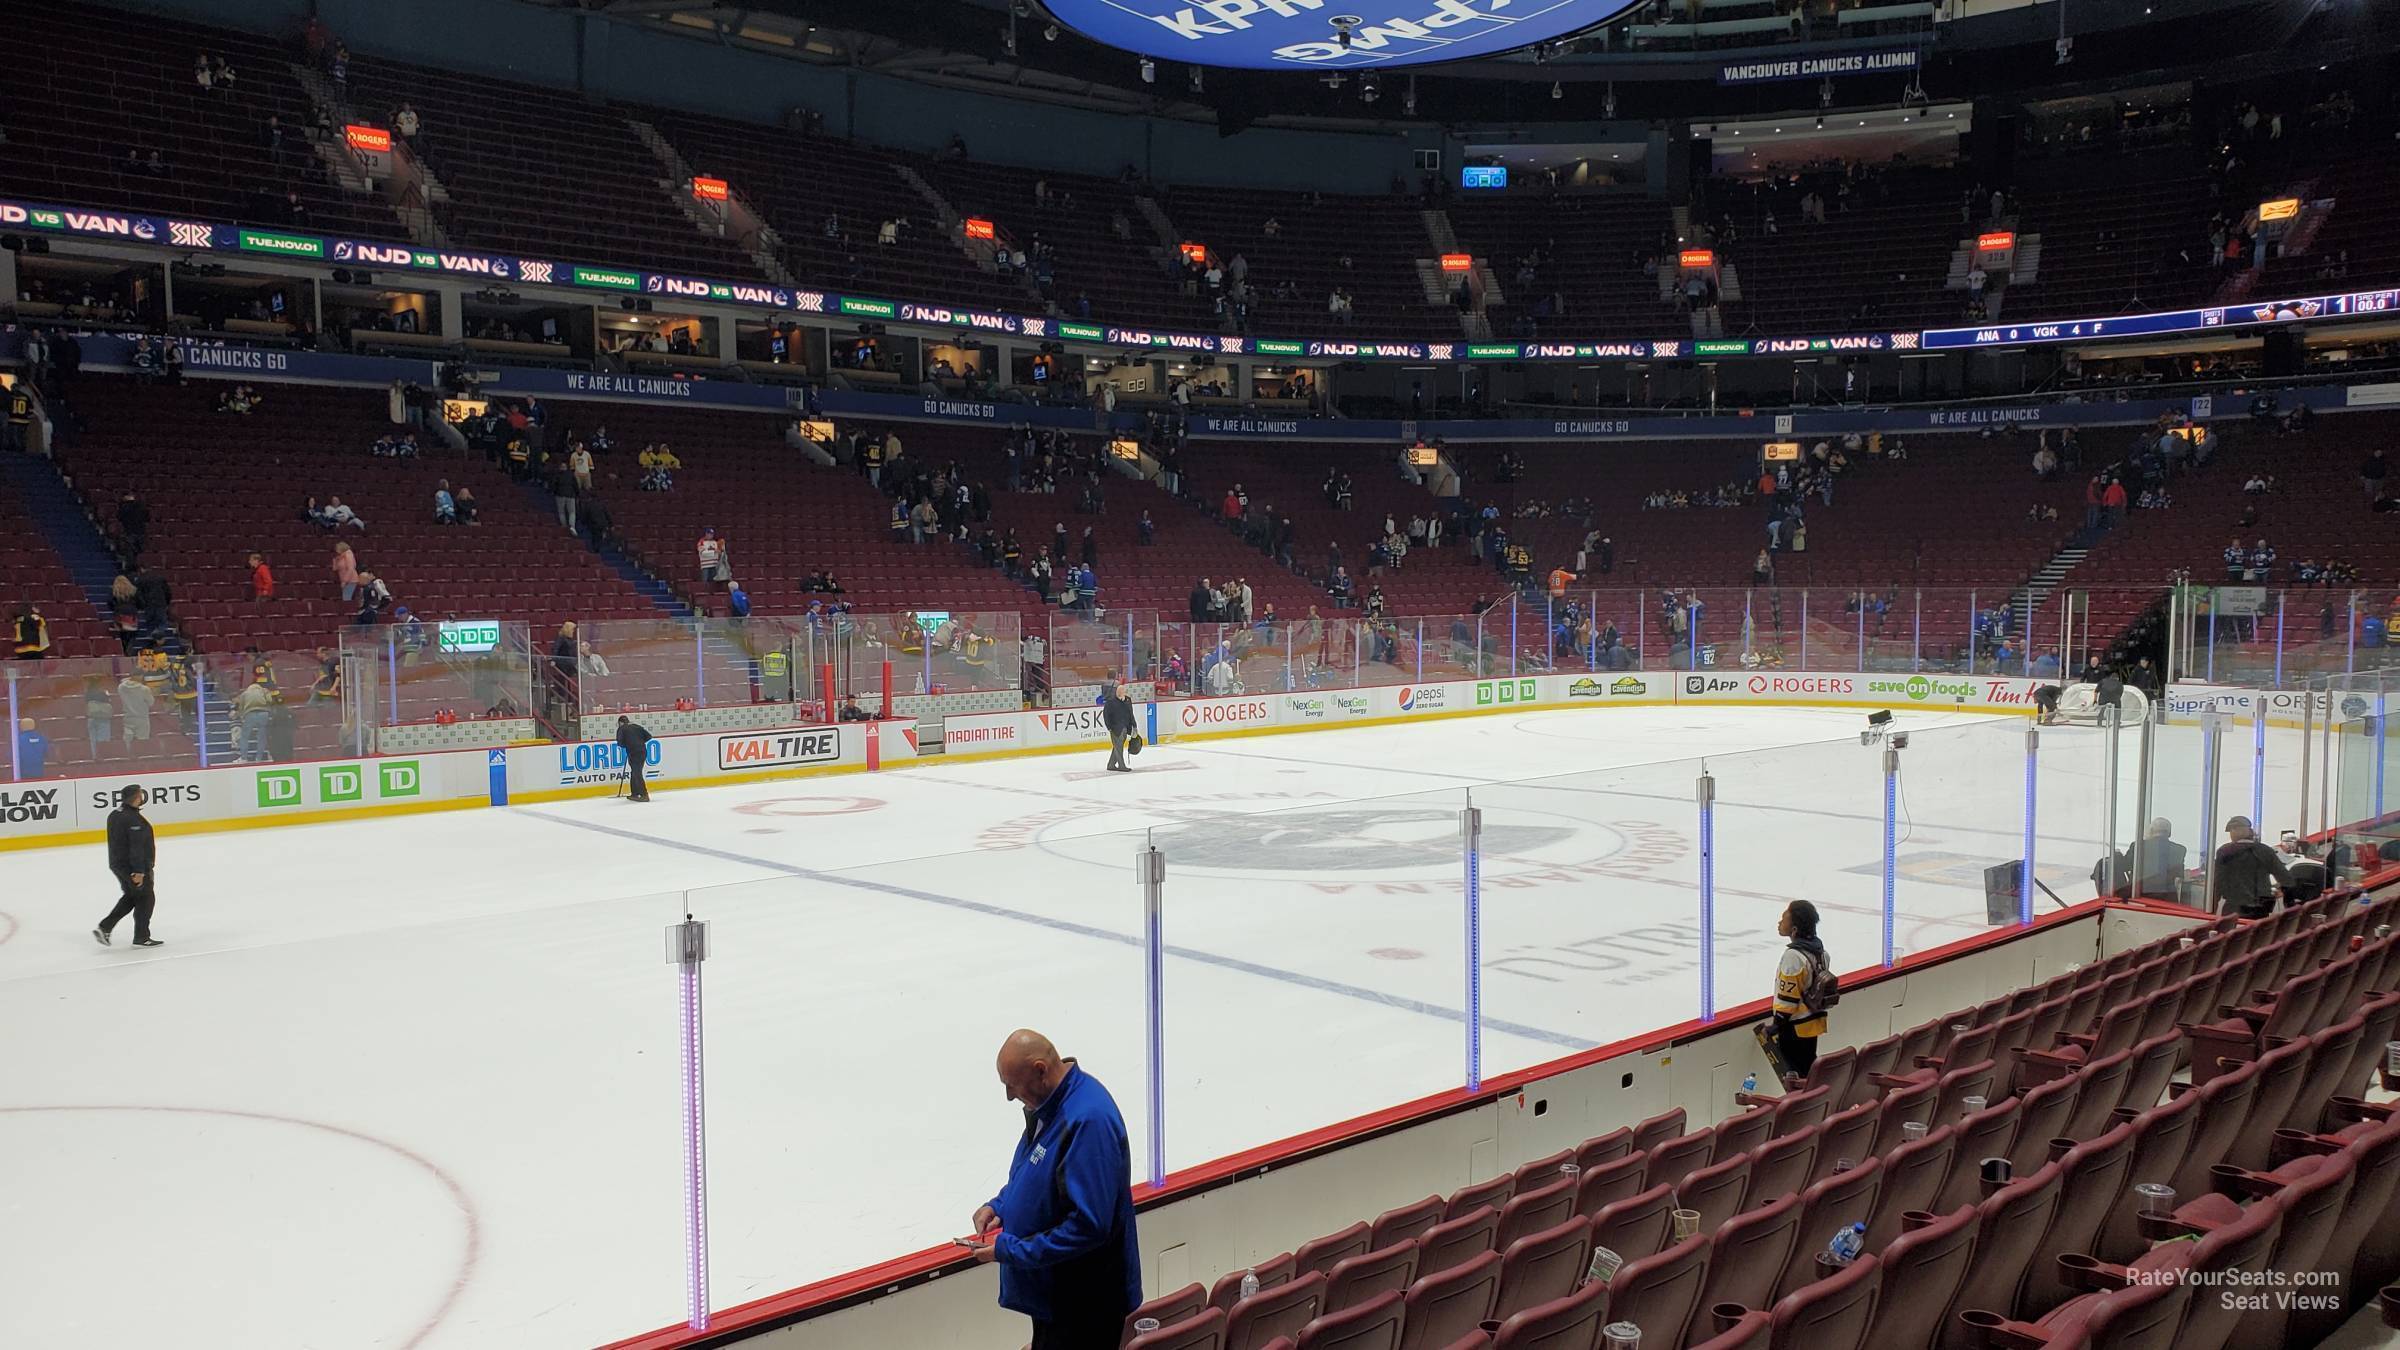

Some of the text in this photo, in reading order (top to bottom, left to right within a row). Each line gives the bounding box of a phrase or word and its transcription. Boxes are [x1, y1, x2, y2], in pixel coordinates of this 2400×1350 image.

[1724, 52, 1916, 81] VANCOUVER CANUCKS ALUMNI
[357, 134, 388, 145] ROGERS
[65, 213, 129, 235] VAN
[246, 237, 318, 252] TUE.NOV.01
[358, 246, 412, 264] NJD
[440, 255, 489, 273] VAN
[666, 279, 710, 296] NJD
[732, 287, 772, 303] VAN
[2335, 297, 2346, 313] 1
[2358, 299, 2385, 311] 00.0
[917, 308, 952, 323] NJD
[970, 314, 1003, 329] VAN
[1121, 331, 1152, 345] NJD
[1169, 335, 1201, 348] VAN
[1976, 331, 2000, 342] ANA
[2033, 326, 2058, 337] VGK
[2072, 325, 2080, 334] 4
[2094, 323, 2102, 333] F
[1324, 344, 1358, 356] NJD
[1376, 345, 1408, 357] VAN
[1540, 346, 1576, 357] NJD
[1595, 345, 1630, 356] VAN
[1771, 340, 1809, 351] NJD
[1830, 337, 1868, 349] VAN
[191, 348, 262, 368] CANUCKS
[267, 354, 287, 370] GO
[567, 374, 690, 396] WE ARE ALL CANUCKS
[924, 400, 995, 418] GO CANUCKS GO
[2193, 398, 2210, 410] 122
[1777, 418, 1790, 427] 121
[1930, 408, 2040, 424] WE ARE ALL CANUCKS
[1208, 419, 1297, 433] WE ARE ALL CANUCKS
[1555, 421, 1629, 433] GO CANUCKS GO
[1703, 653, 1715, 665] 92
[1477, 682, 1535, 701] TD TD TD
[1570, 685, 1602, 696] Cavendish
[1611, 683, 1646, 695] Cavendish
[1773, 678, 1852, 693] ROGERS
[1986, 681, 2020, 704] Tim
[1416, 685, 1444, 704] pepsi
[1293, 697, 1324, 713] NexGen
[1337, 696, 1368, 710] NexGen
[1350, 706, 1367, 716] Energy
[1203, 701, 1267, 723] ROGERS
[1305, 709, 1324, 719] Energy
[1054, 709, 1105, 732] FASK
[992, 725, 1015, 741] TIRE
[560, 739, 662, 774] LORDO
[260, 766, 416, 801] TD TD TD
[577, 771, 632, 785] AUTO PAR
[0, 788, 57, 807] LAY
[1779, 980, 1796, 993] 87
